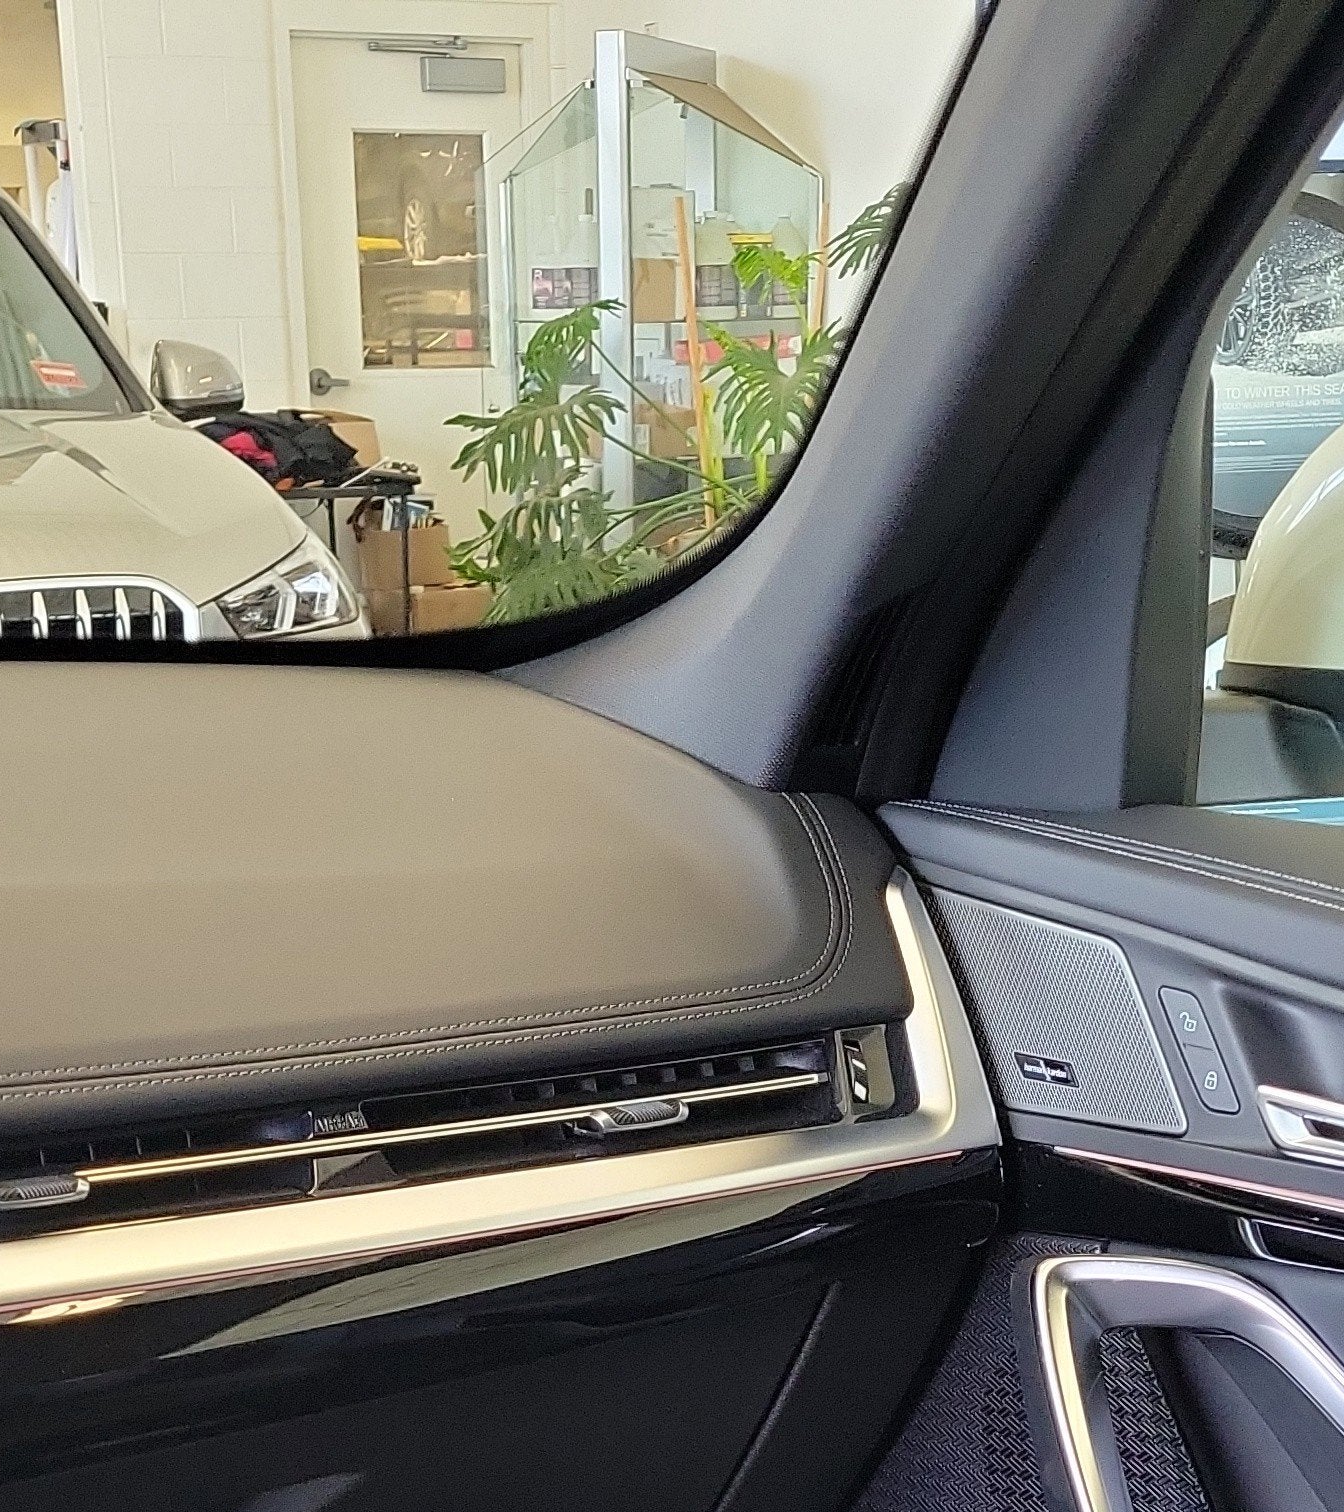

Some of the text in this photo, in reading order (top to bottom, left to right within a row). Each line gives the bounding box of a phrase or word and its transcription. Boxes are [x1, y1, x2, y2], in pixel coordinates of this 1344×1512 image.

[1226, 388, 1240, 399] TO
[1244, 386, 1289, 398] WINTER
[1295, 384, 1320, 396] THIS
